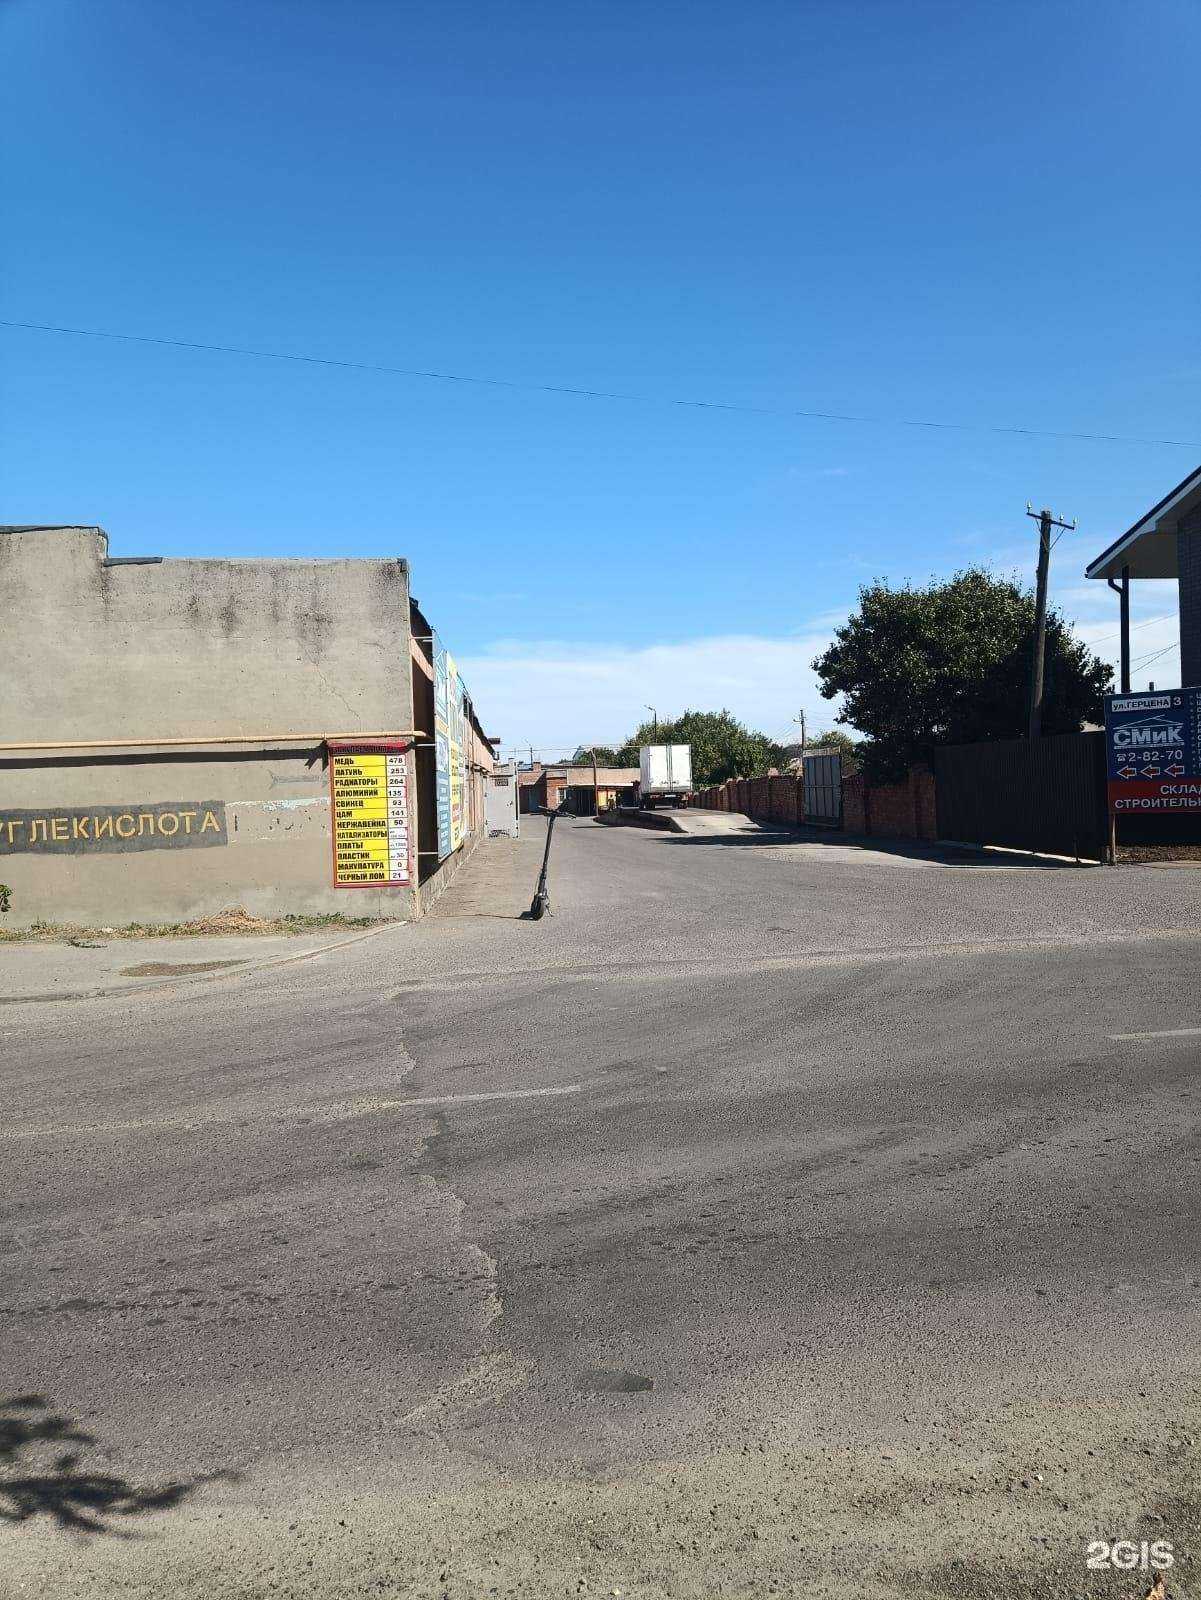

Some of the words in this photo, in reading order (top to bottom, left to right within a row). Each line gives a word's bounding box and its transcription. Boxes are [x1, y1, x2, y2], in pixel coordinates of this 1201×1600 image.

[1113, 726, 1184, 746] СМиК
[1128, 750, 1183, 762] 2-82-70
[335, 758, 354, 766] МЕДЬ
[335, 778, 378, 787] РАДИАТОРЫ
[335, 789, 379, 798] АЛЮМИНИЙ
[336, 800, 364, 808] СВИНЕЦ
[1114, 798, 1201, 809] СТРОИТЕЛЬ
[336, 811, 353, 819] ЦАМ
[0, 811, 221, 844] ГЛЕКИСЛОТА
[337, 819, 387, 829] НЕРЖАВЕЙКА
[337, 830, 387, 839] КАТАЛИЗАТОРЫ
[337, 842, 364, 850] ПЛАТЫ
[337, 852, 370, 861] ПЛАСТИК
[337, 862, 385, 871] МАКУЛАТУРА
[369, 872, 385, 880] ЛОМ
